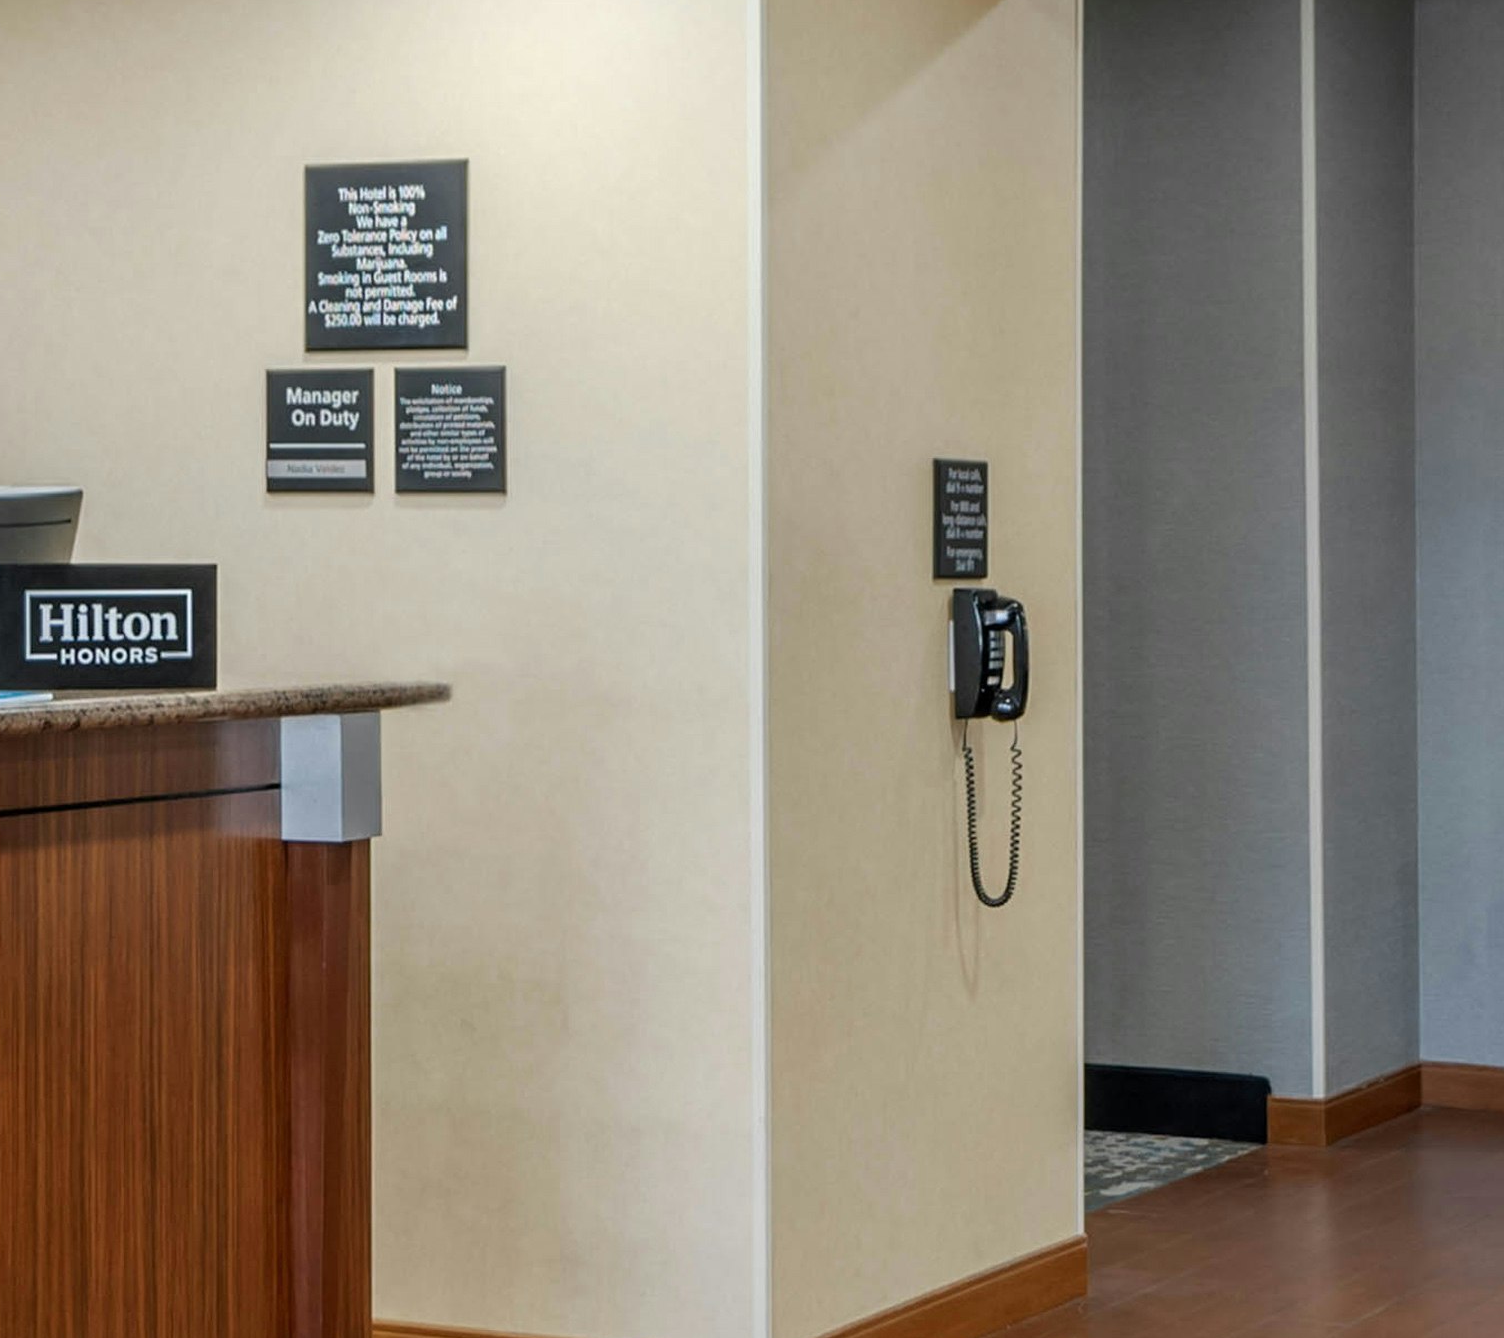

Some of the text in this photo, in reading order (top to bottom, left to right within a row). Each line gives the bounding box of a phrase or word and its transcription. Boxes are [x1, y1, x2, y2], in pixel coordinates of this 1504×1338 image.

[338, 187, 358, 202] This
[359, 186, 386, 200] Hotel
[398, 184, 426, 200] 100%
[356, 216, 408, 229] We have a
[317, 230, 340, 245] Zero
[341, 229, 387, 243] Tolerance
[389, 228, 418, 243] Policy
[419, 229, 433, 241] on
[318, 270, 360, 287] Smoking
[373, 270, 402, 284] Guest
[403, 269, 437, 283] Rooms
[308, 295, 458, 315] A Cleaning and Damage Fee of
[383, 312, 397, 325] be
[286, 387, 359, 408] Manager
[292, 409, 360, 431] On Duty
[37, 602, 179, 642] Hilton
[60, 647, 158, 665] HONORS
